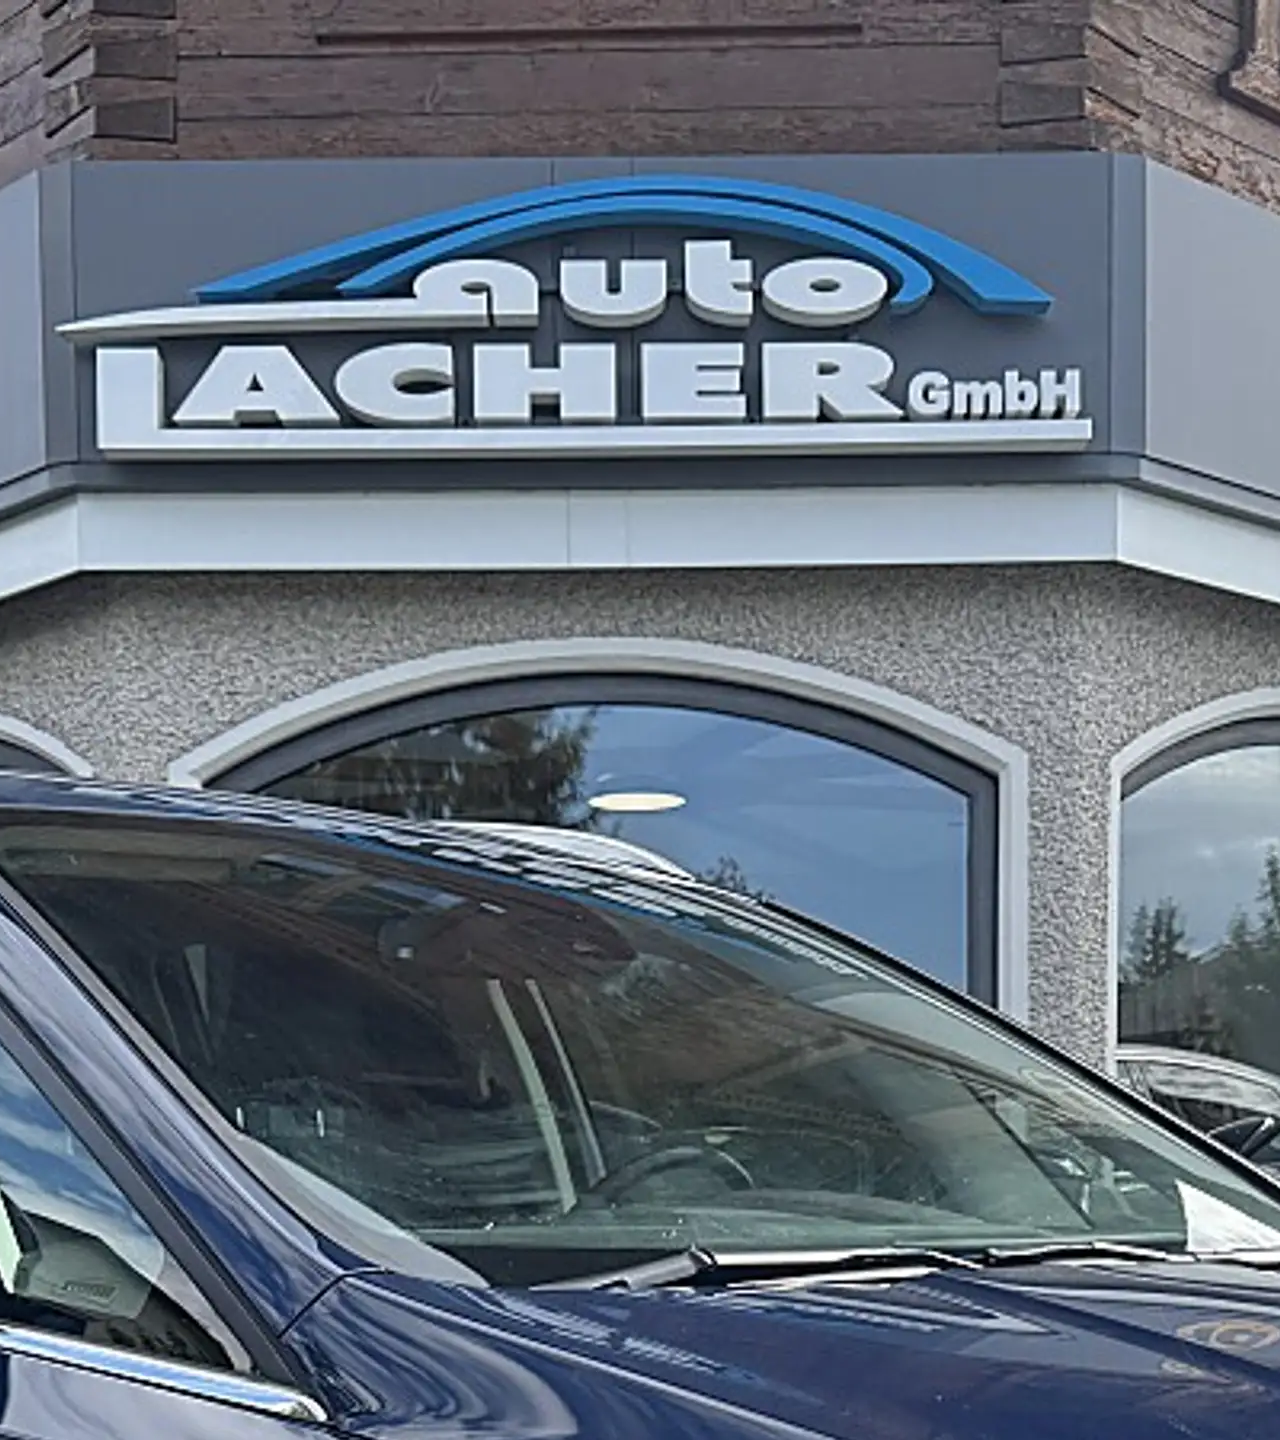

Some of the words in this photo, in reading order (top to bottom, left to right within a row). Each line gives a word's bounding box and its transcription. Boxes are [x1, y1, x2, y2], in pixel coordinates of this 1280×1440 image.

[412, 239, 890, 328] auto
[95, 340, 906, 460] LACHER
[907, 368, 1083, 420] GmbH
